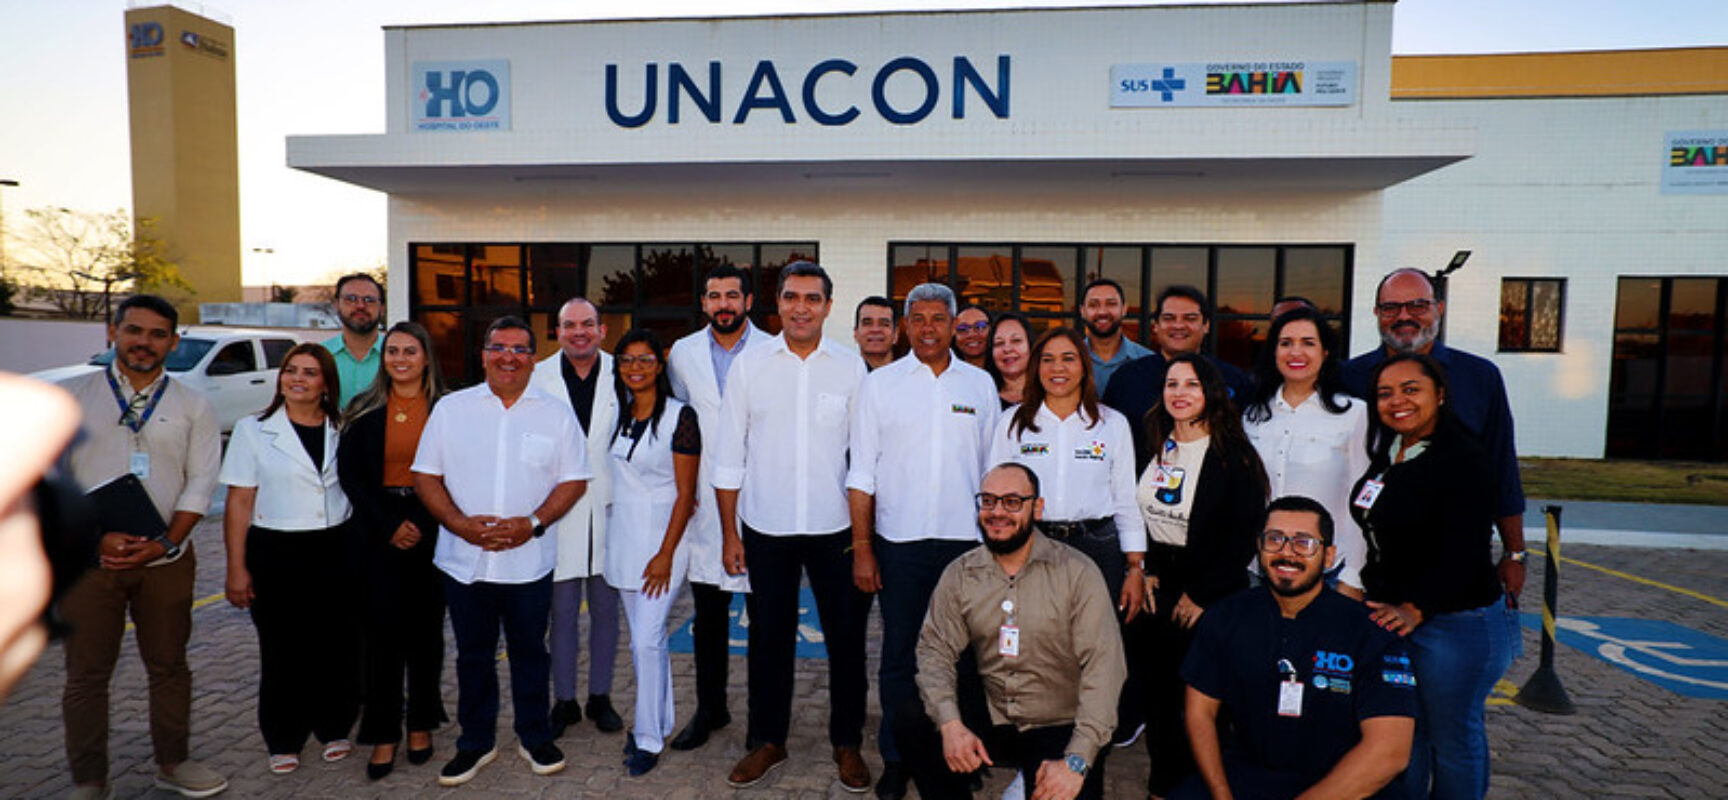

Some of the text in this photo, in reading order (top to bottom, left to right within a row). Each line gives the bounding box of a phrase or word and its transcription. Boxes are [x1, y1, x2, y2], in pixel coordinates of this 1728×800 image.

[1206, 62, 1305, 72] GOVERNO DO ESTADO
[426, 69, 499, 117] HO
[605, 55, 1011, 128] UNACON
[1121, 80, 1149, 91] SUS
[1205, 72, 1304, 94] BAHIA
[1314, 650, 1354, 671] HO
